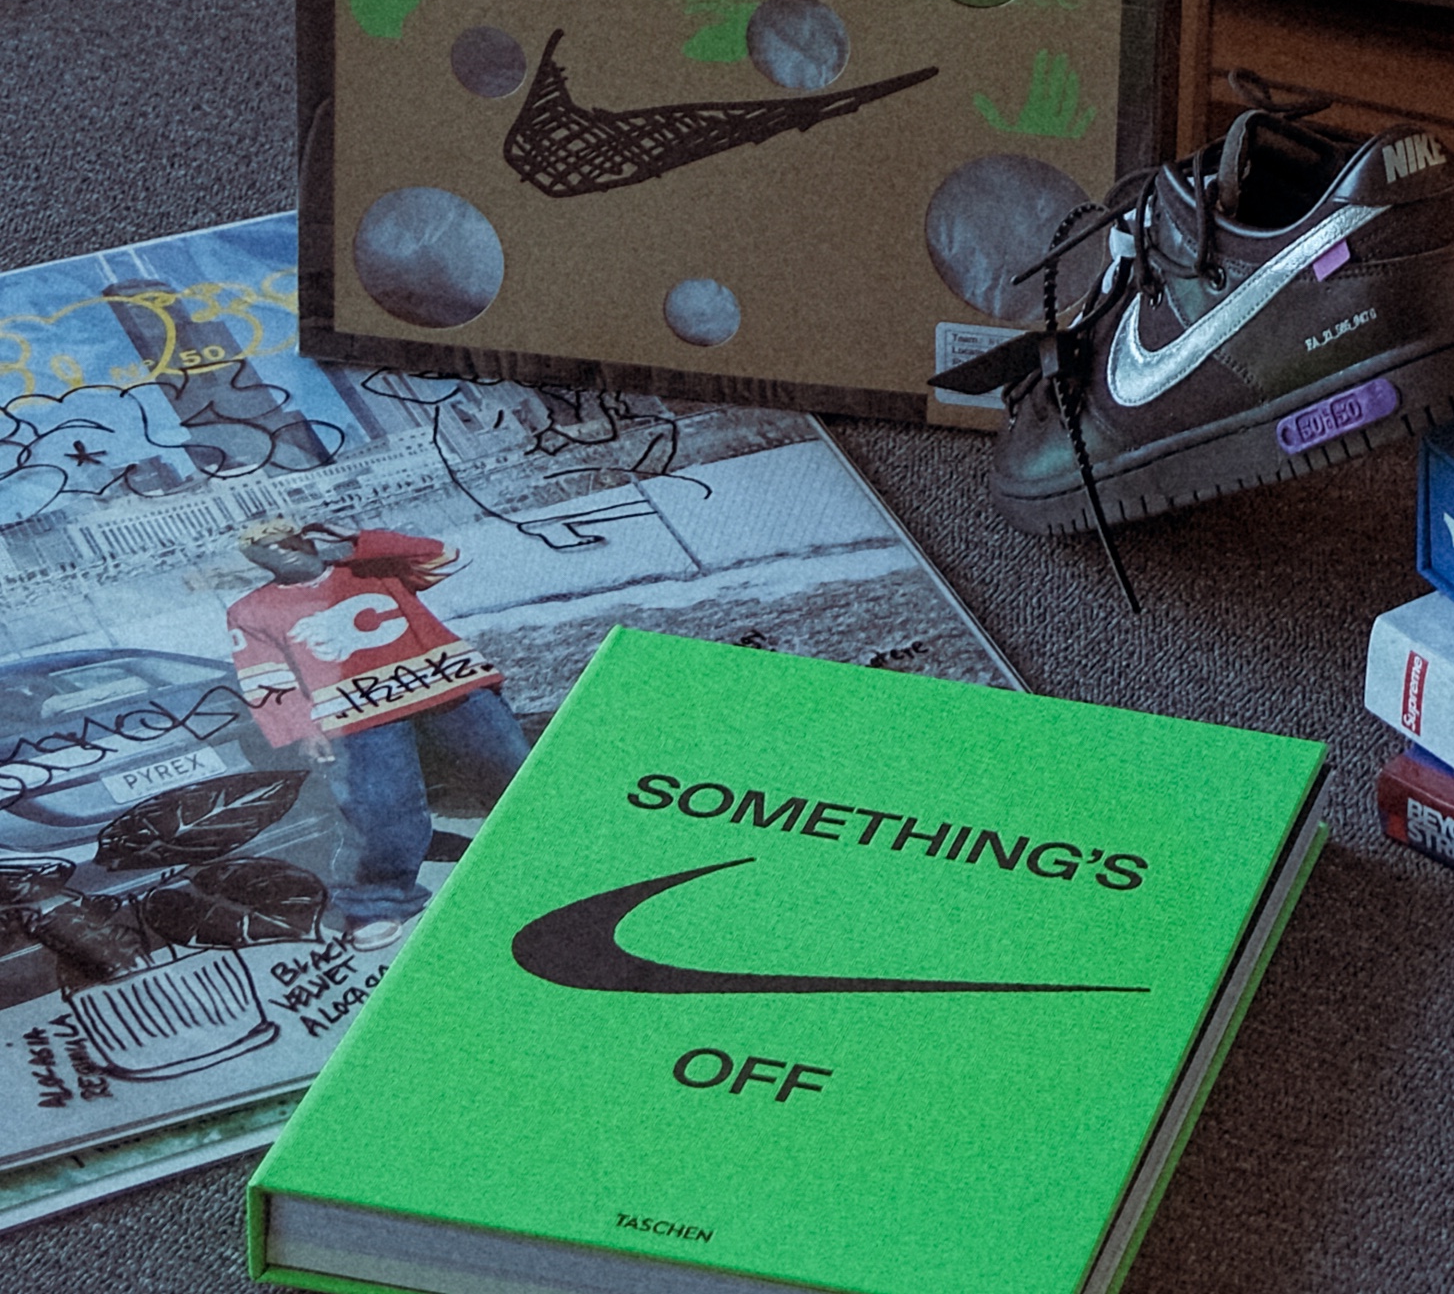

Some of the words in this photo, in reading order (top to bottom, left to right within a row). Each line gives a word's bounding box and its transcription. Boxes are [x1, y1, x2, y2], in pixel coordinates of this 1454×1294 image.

[1381, 133, 1447, 184] NIKE
[179, 345, 226, 366] 50
[1402, 655, 1424, 731] Supreme
[122, 753, 206, 790] PYREX
[626, 772, 1151, 892] SOMETHING’S
[268, 954, 358, 1013] VELVET
[270, 932, 354, 987] BLACK
[672, 1046, 834, 1104] OFF
[615, 1212, 714, 1246] TASCHEN
